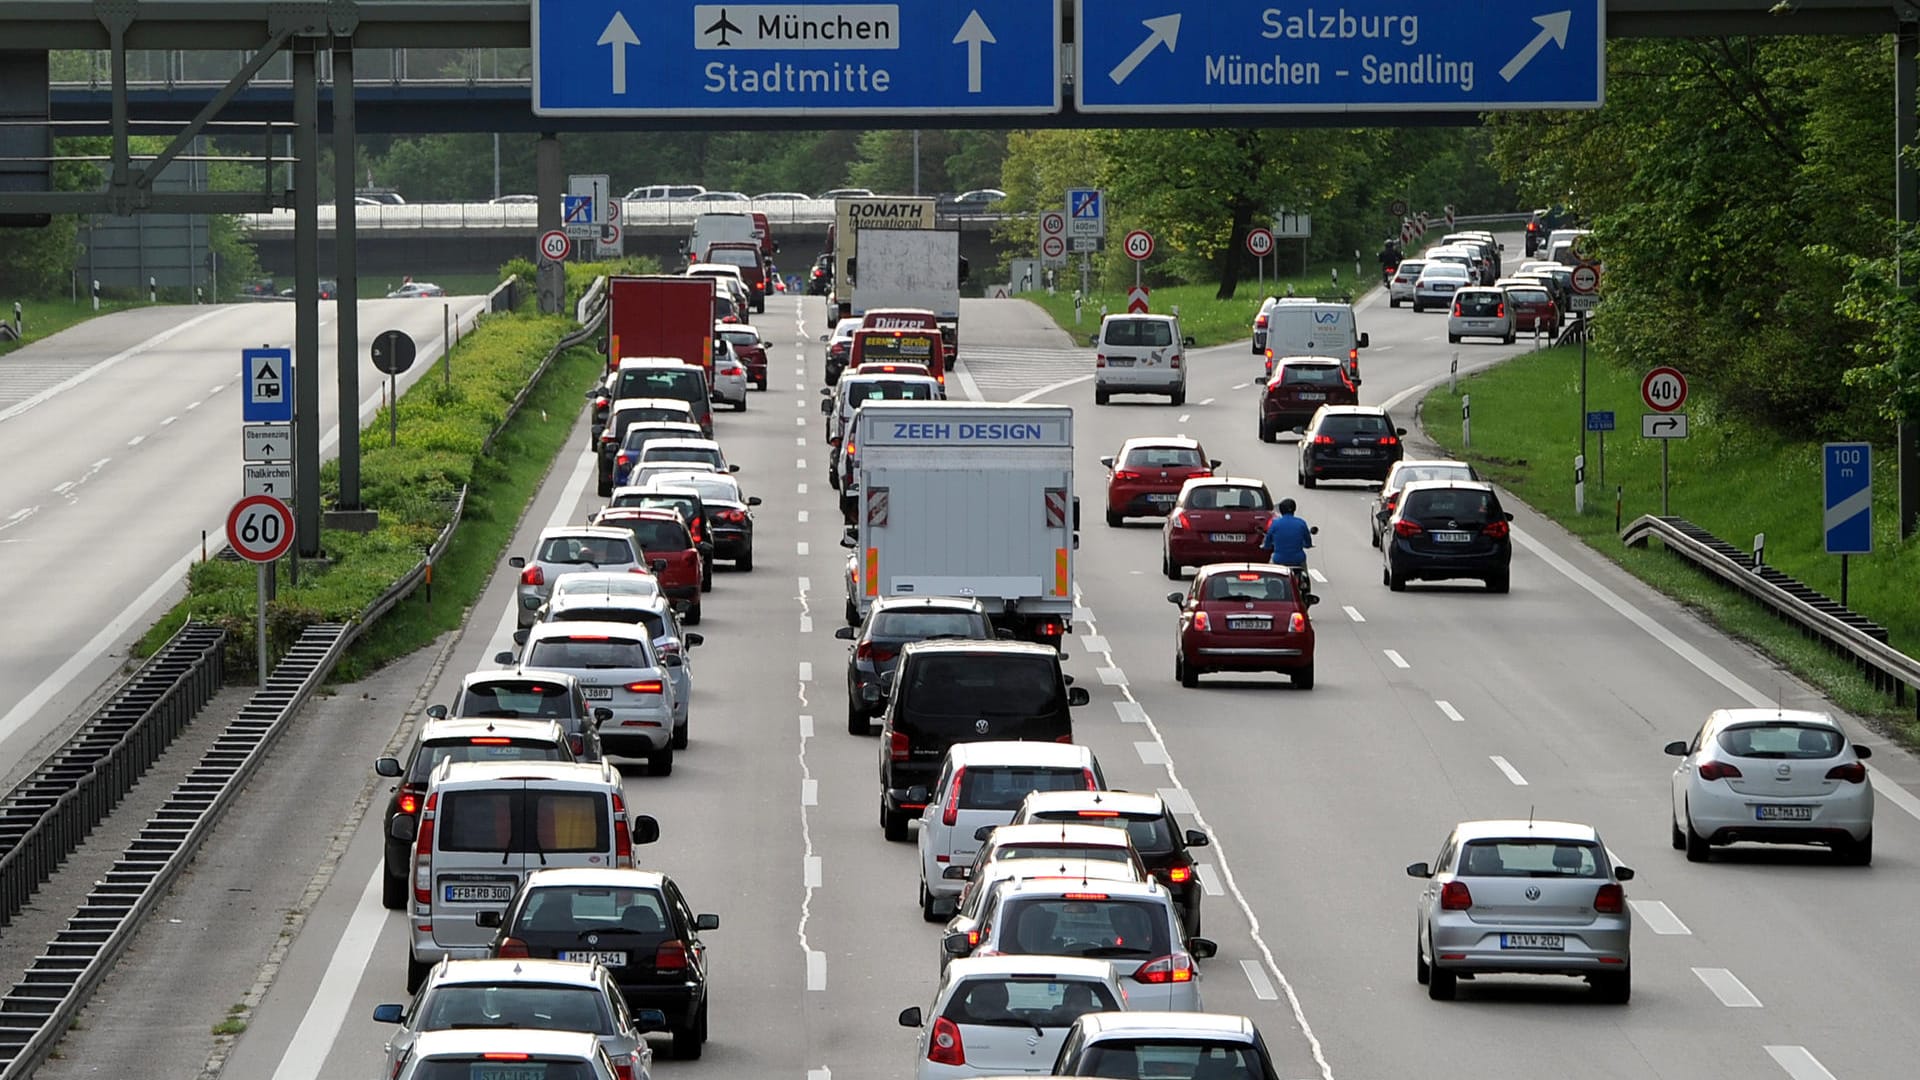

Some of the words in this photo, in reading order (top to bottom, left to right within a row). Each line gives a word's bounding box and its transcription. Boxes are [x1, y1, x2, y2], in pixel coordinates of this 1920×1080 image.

[758, 14, 890, 40] München
[1261, 8, 1418, 46] Salzburg
[704, 61, 890, 93] Stadtmitte
[1205, 54, 1320, 85] München
[1361, 53, 1474, 92] Sendling
[849, 203, 922, 217] DONATH
[849, 217, 922, 228] International
[1047, 219, 1060, 229] 60
[547, 239, 564, 252] 60
[1130, 238, 1147, 252] 60
[246, 431, 289, 440] Obermenzing
[894, 423, 950, 439] ZEEH
[959, 423, 1041, 439] DESIGN
[1834, 450, 1860, 465] 100
[247, 468, 290, 479] Thalkirchen
[1841, 468, 1854, 478] m
[241, 513, 279, 543] 60
[452, 887, 471, 899] FFB
[476, 888, 490, 899] RB
[491, 888, 510, 899] 300
[1540, 936, 1561, 947] 202
[601, 952, 621, 965] 541
